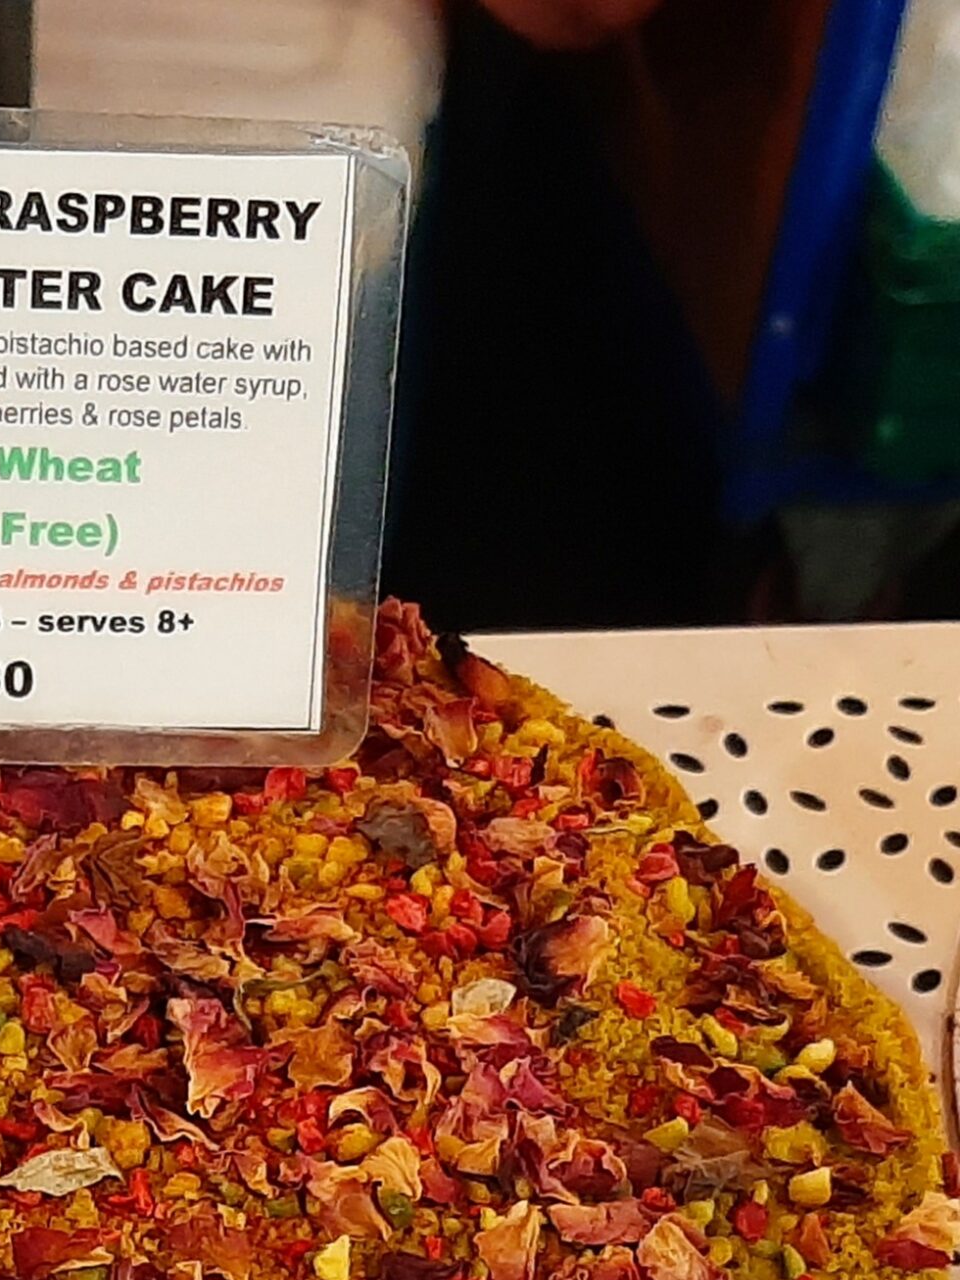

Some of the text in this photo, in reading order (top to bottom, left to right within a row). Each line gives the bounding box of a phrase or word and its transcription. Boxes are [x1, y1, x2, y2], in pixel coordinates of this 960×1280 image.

[122, 272, 274, 316] CAKE
[113, 333, 188, 359] based
[196, 334, 254, 360] cake
[263, 338, 311, 362] with
[15, 365, 65, 391] with
[74, 373, 88, 390] a
[98, 374, 151, 392] rose
[158, 371, 228, 394] water
[234, 377, 307, 402] syrup,
[82, 402, 98, 426] &
[109, 409, 161, 427] rose
[1, 512, 118, 556] Free)
[118, 571, 137, 590] &
[145, 572, 284, 595] pistachios
[38, 615, 145, 634] serves
[157, 610, 194, 634] 8+
